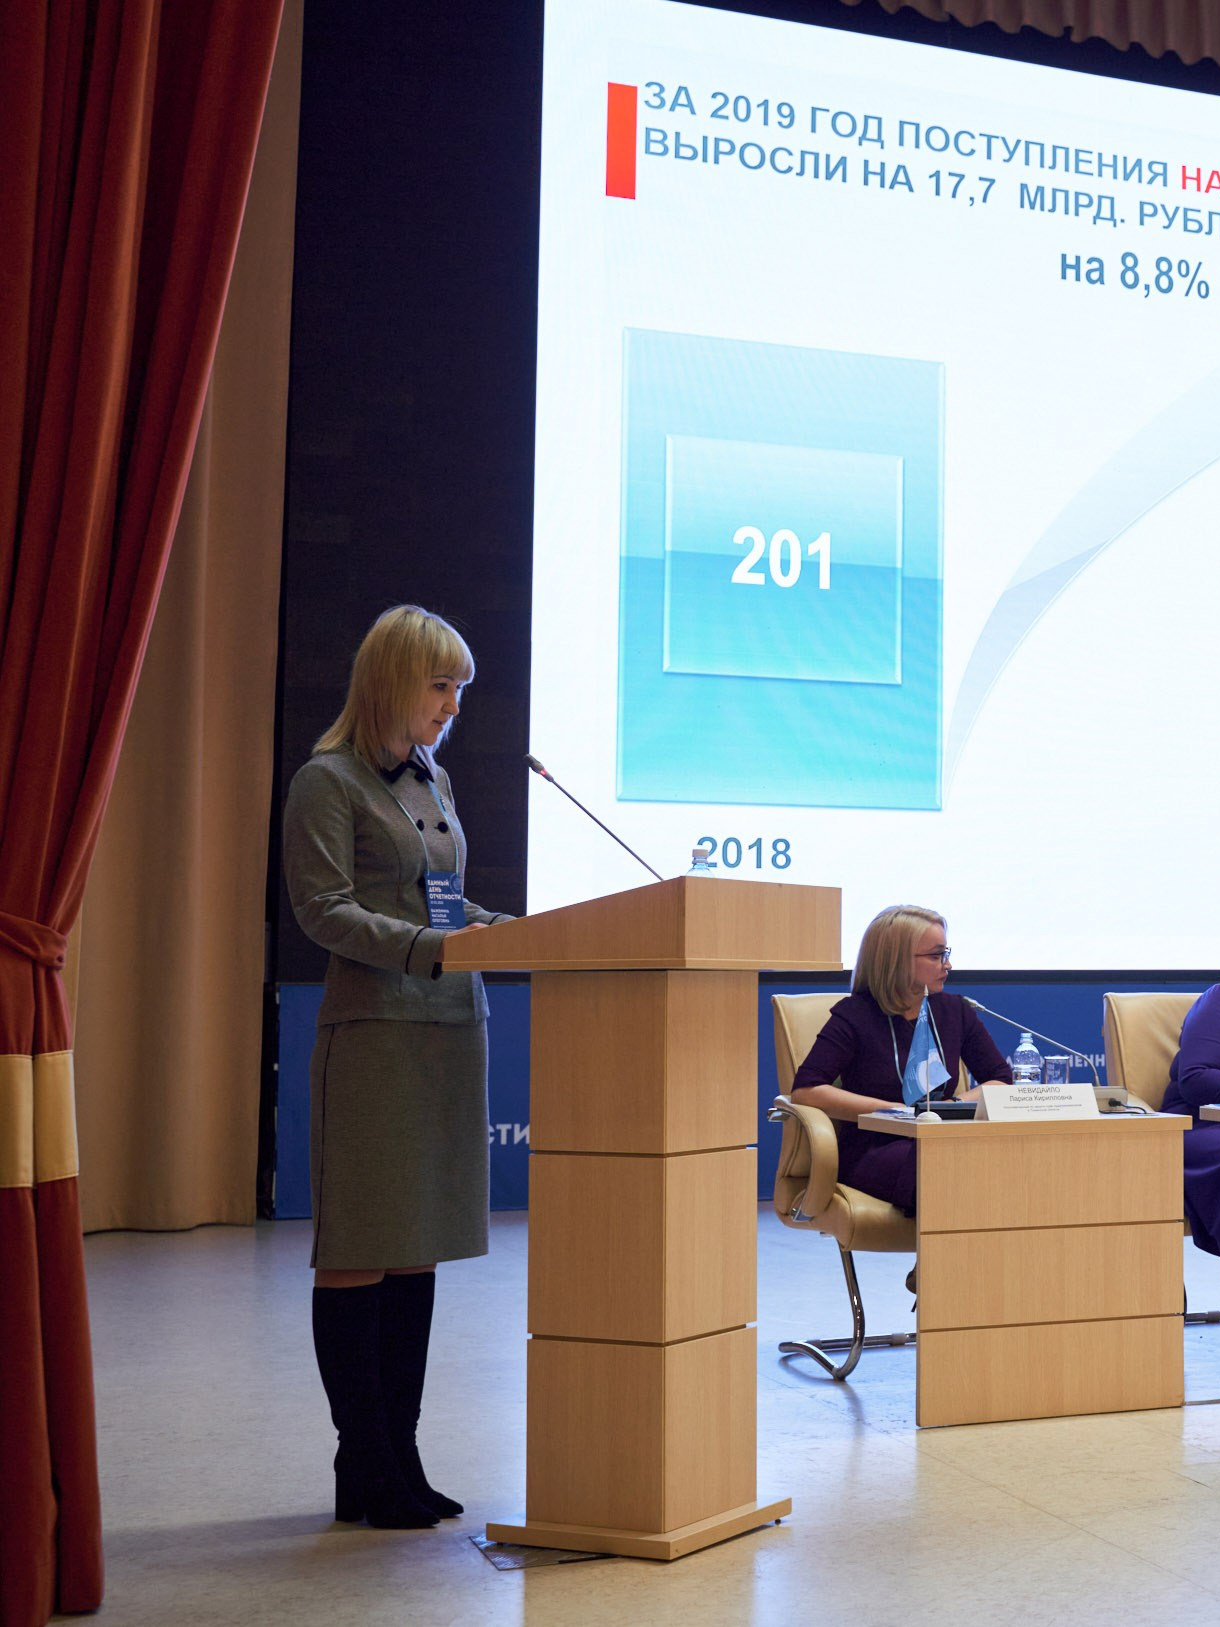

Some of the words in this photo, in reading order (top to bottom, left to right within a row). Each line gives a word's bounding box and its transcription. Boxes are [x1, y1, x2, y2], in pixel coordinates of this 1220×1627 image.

[643, 80, 697, 117] ЗА
[709, 91, 796, 130] 2019
[810, 105, 886, 150] ГОД
[898, 119, 1168, 188] ПОСТУПЛЕНИЯ
[643, 126, 848, 184] ВЫРОСЛИ
[863, 158, 915, 193] НА
[928, 169, 997, 208] 17,7
[1019, 182, 1126, 229] МЛРД.
[1060, 252, 1106, 286] на
[1119, 251, 1210, 300] 8,8%
[732, 526, 831, 589] 201
[696, 836, 792, 870] 2018
